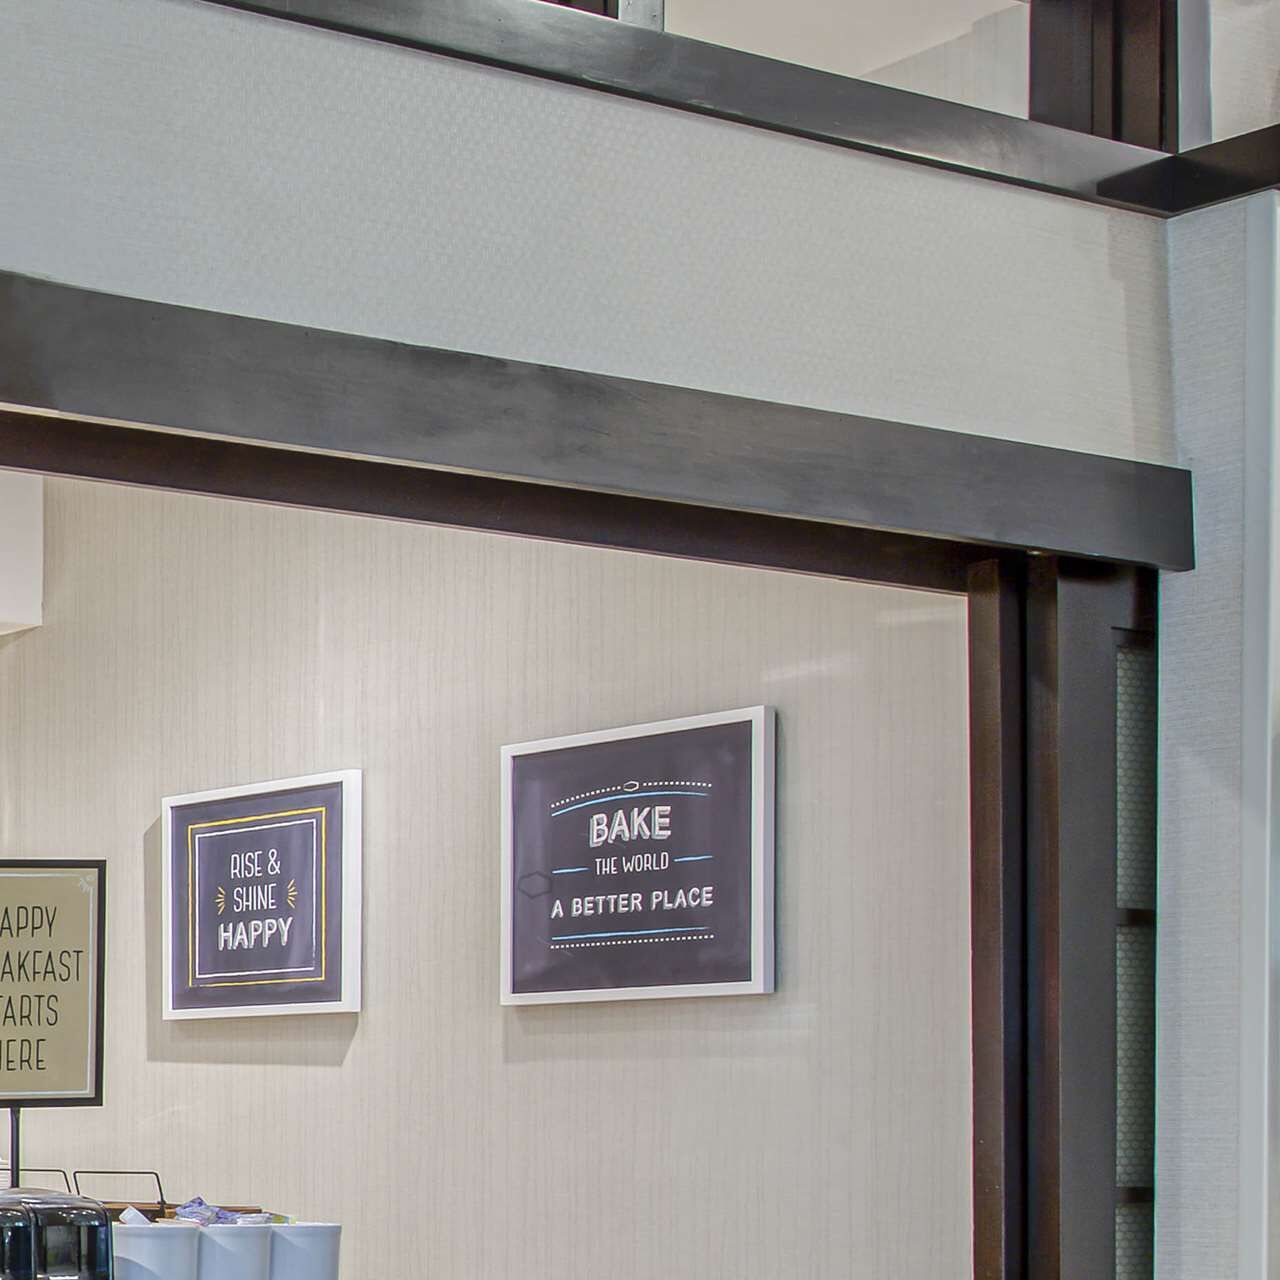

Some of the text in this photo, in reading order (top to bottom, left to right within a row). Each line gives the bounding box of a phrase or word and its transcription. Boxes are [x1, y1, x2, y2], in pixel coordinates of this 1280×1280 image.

[590, 805, 672, 848] BAKE
[230, 848, 281, 879] RISE &
[595, 852, 669, 875] THE WORLD
[233, 883, 277, 913] SHINE
[551, 886, 713, 919] A BETTER PLACE
[218, 916, 293, 951] HAPPY
